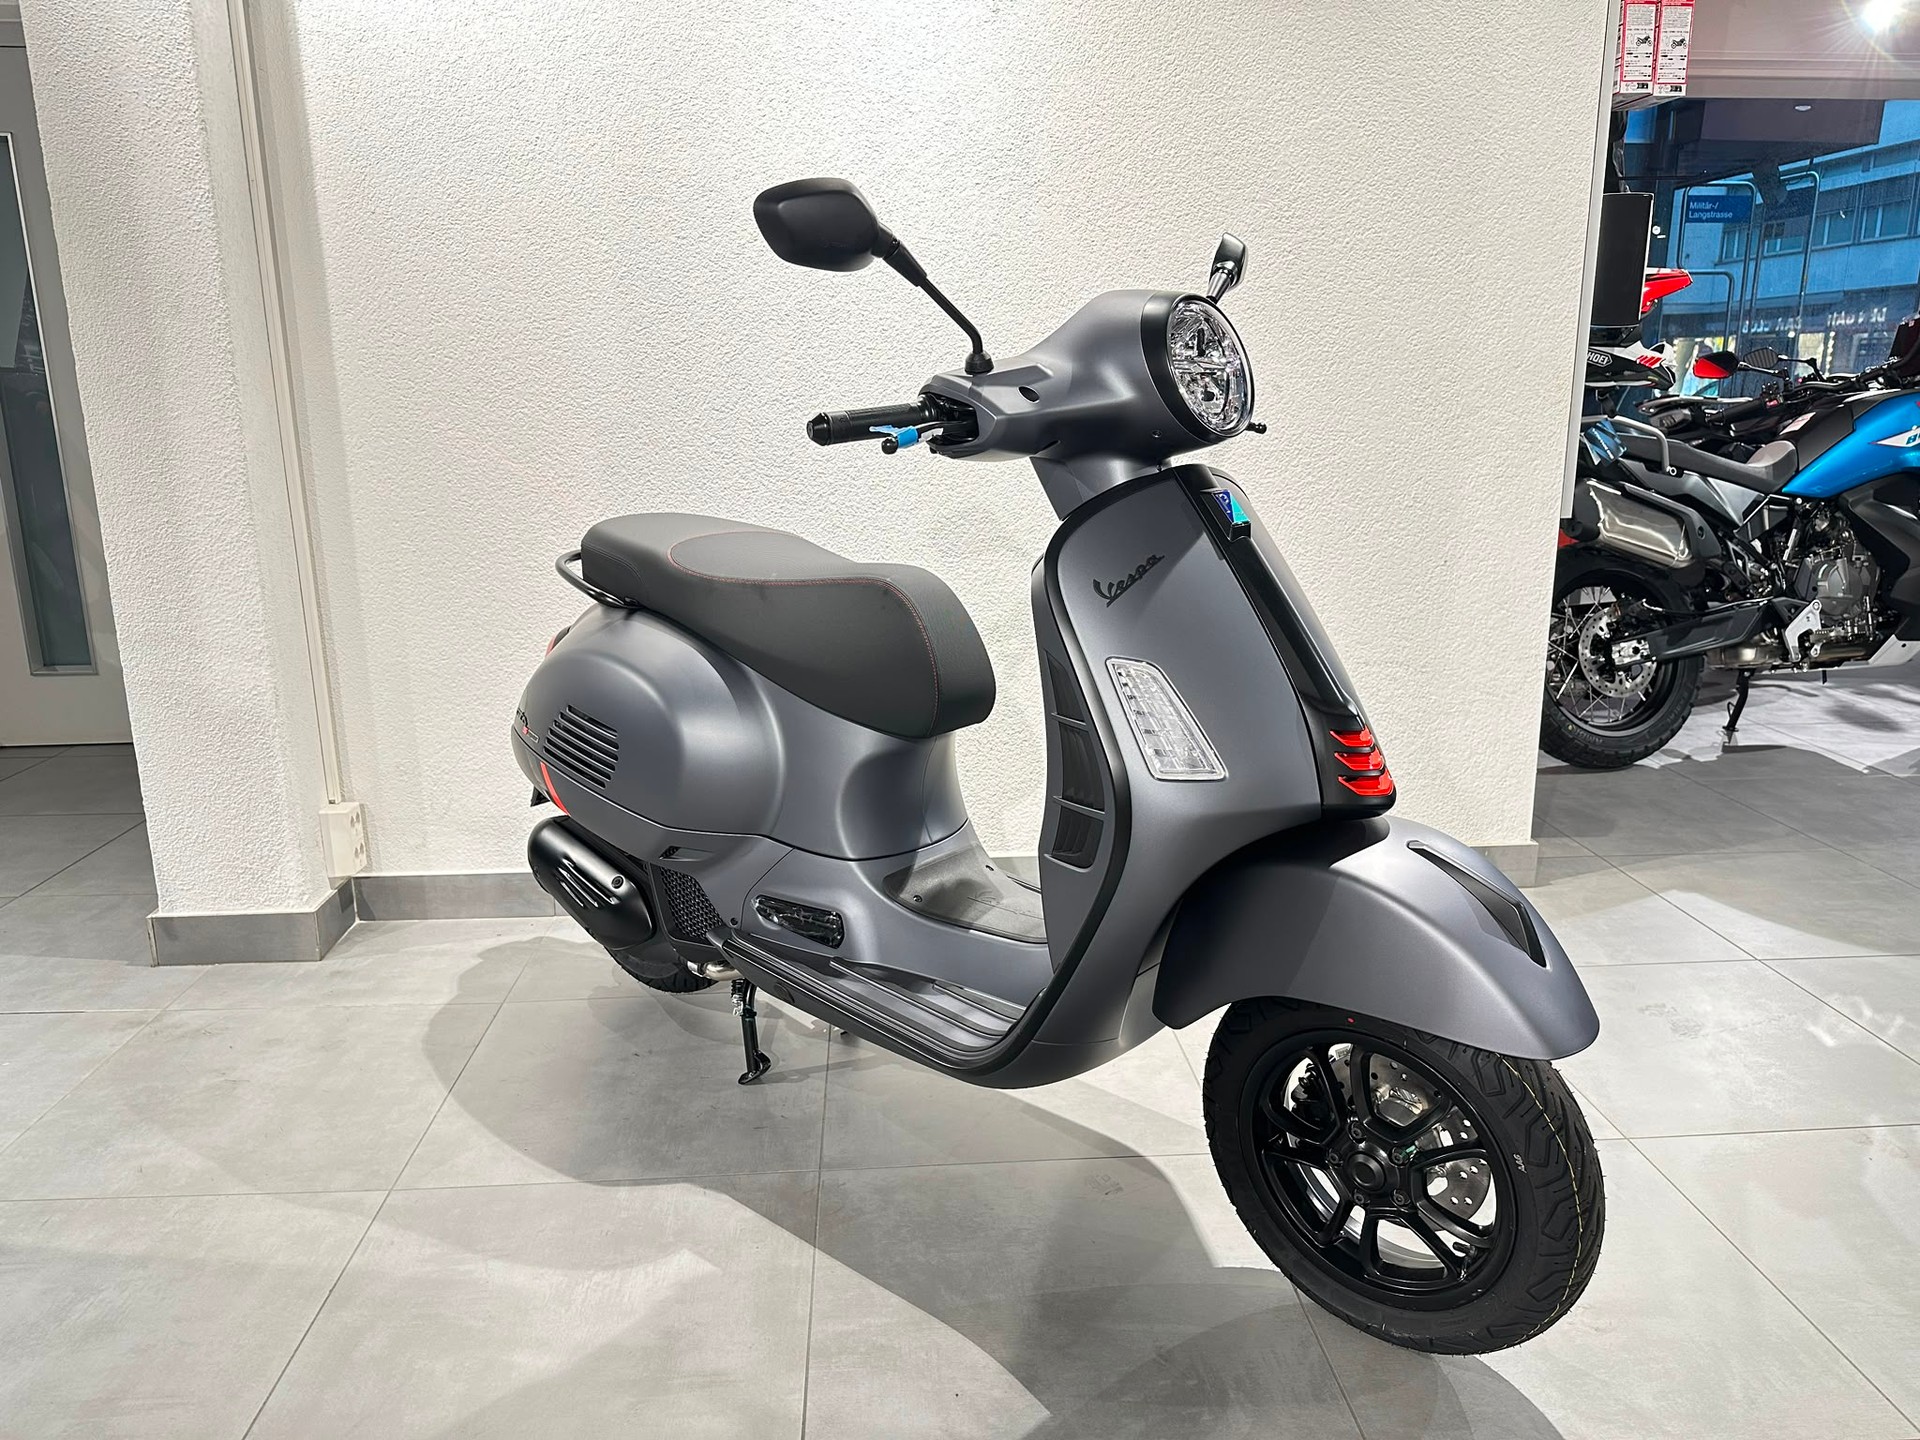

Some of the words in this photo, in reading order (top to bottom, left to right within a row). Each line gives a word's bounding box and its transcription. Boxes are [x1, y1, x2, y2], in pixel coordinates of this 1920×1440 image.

[1689, 211, 1733, 220] Langstrasse
[1587, 351, 1609, 365] HOEI
[1093, 554, 1165, 608] Vespa
